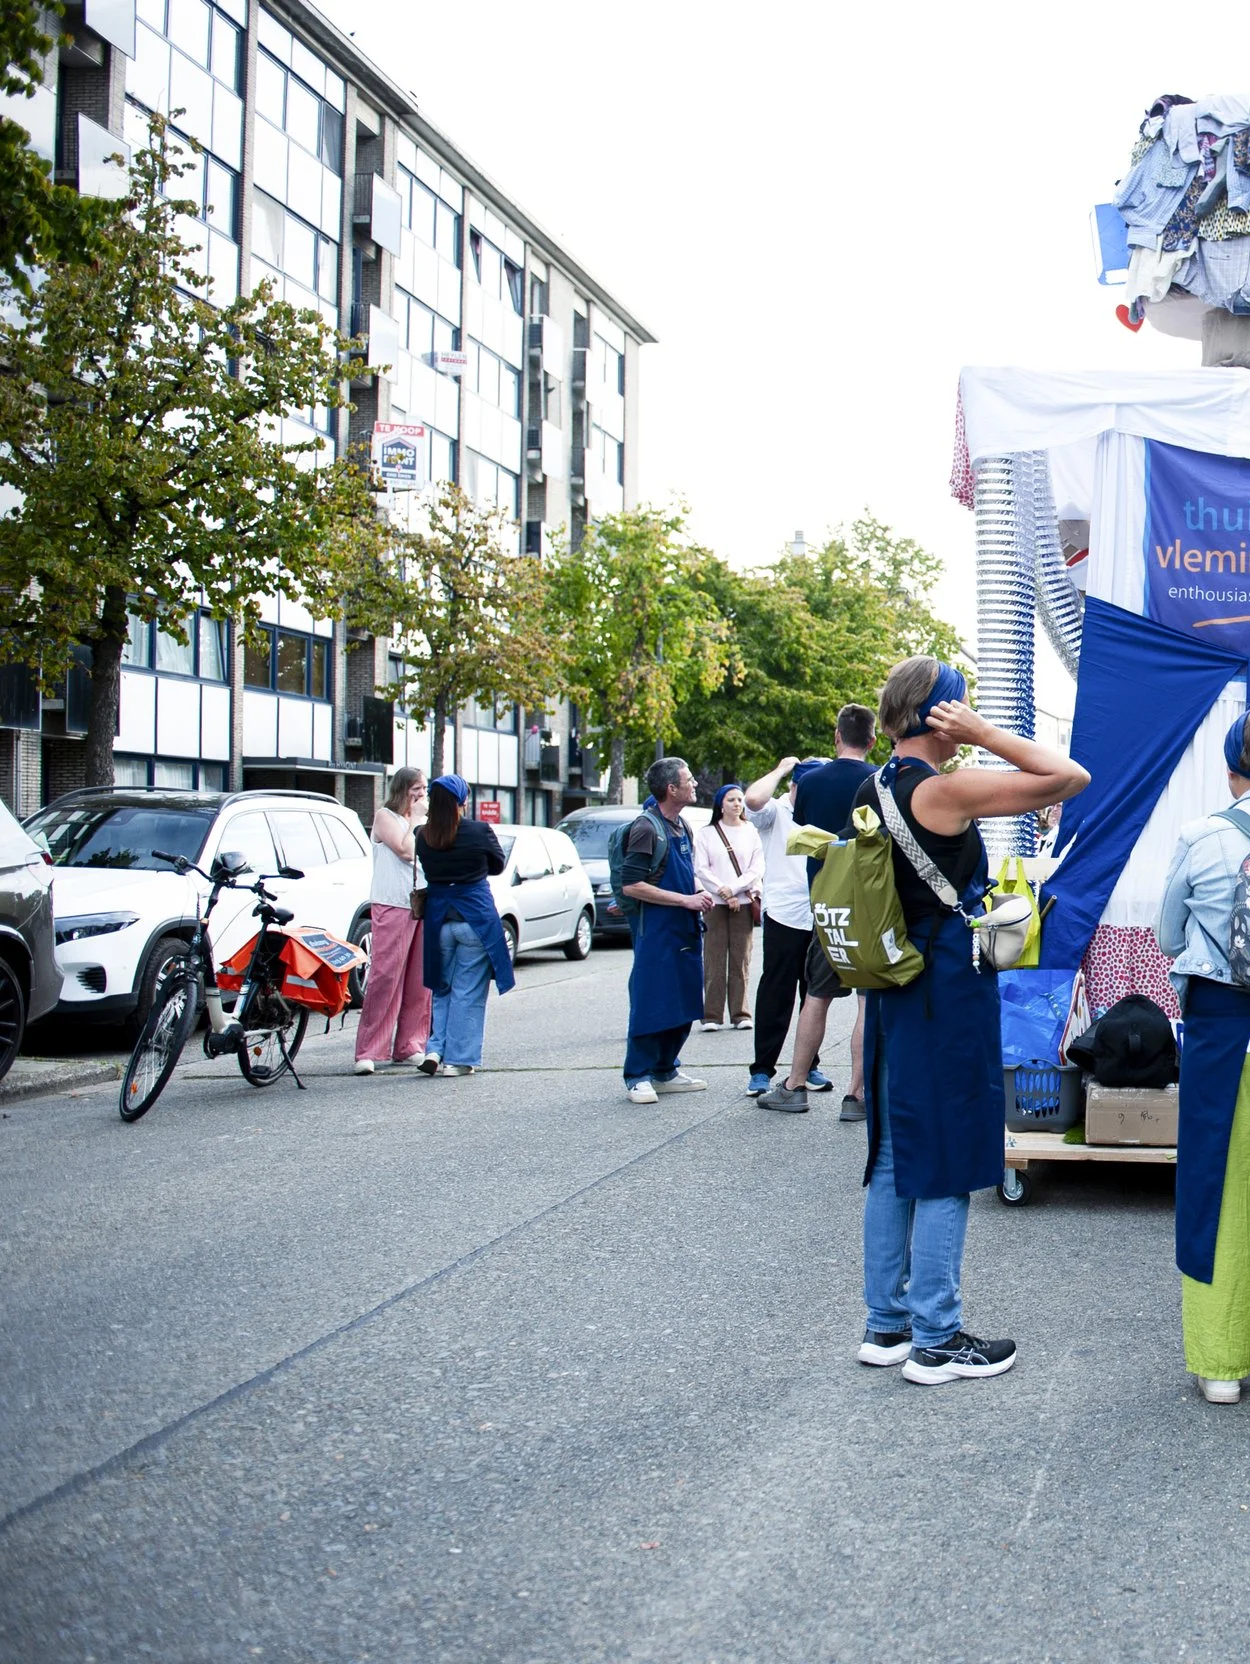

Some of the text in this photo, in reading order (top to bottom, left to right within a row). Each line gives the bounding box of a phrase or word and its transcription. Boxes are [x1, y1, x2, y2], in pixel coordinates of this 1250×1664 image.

[383, 446, 415, 458] IMMO
[814, 903, 851, 927] ÖTZ
[824, 928, 858, 947] TAL
[826, 945, 851, 964] ER
